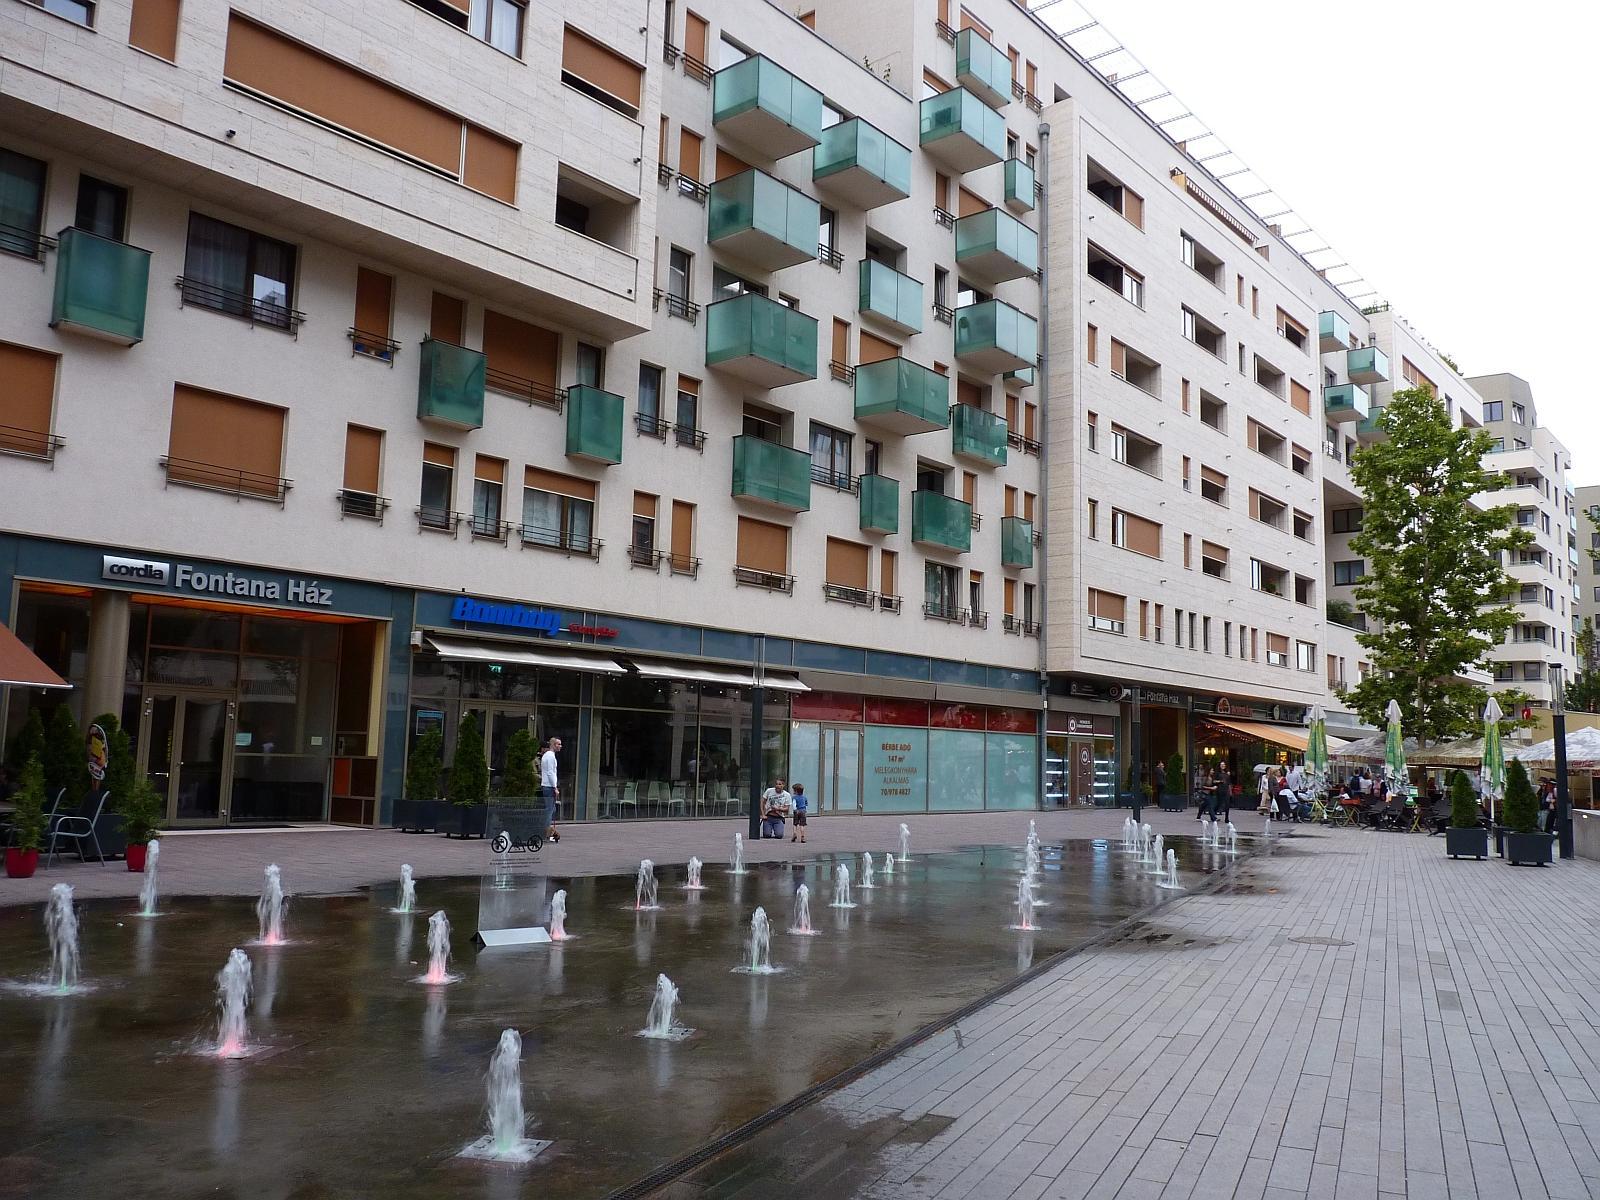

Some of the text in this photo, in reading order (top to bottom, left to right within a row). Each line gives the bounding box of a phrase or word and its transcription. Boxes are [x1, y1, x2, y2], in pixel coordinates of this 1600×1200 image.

[109, 562, 164, 580] cordia
[175, 564, 333, 606] Fontana Ház
[452, 597, 561, 636] Bombay
